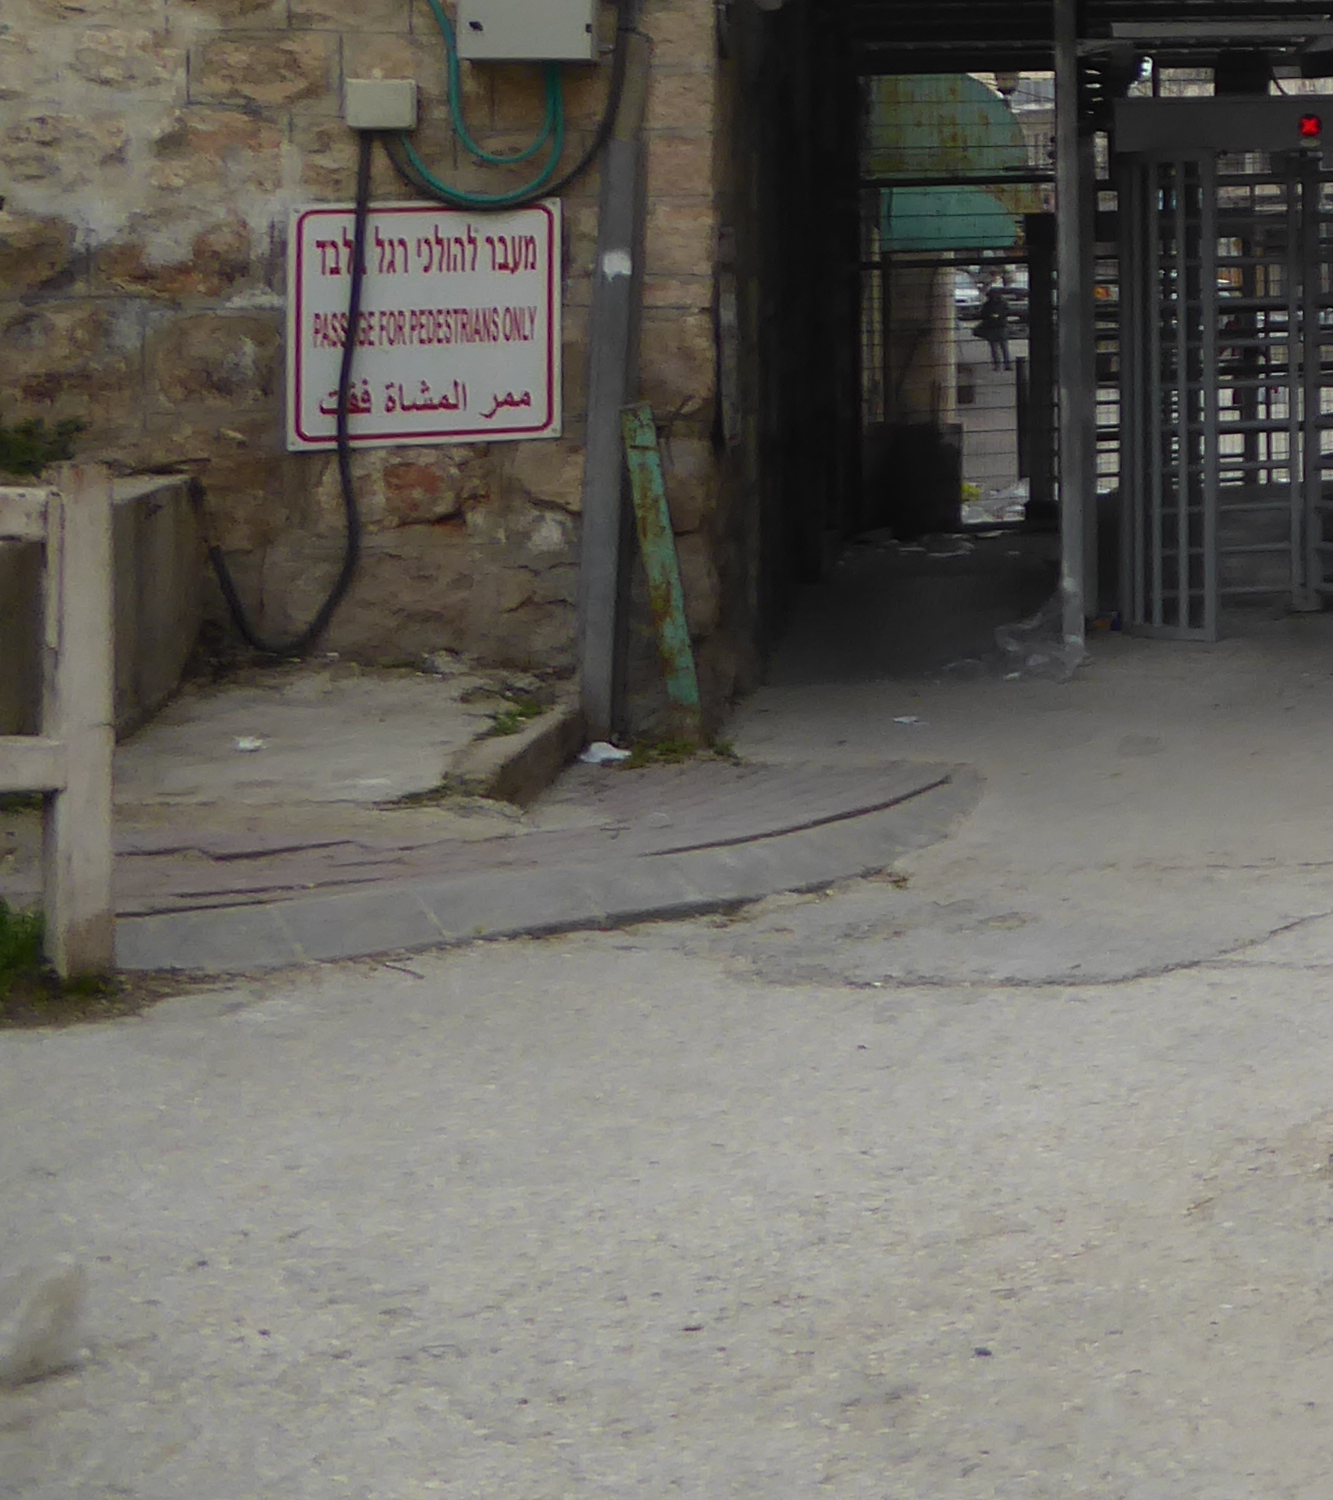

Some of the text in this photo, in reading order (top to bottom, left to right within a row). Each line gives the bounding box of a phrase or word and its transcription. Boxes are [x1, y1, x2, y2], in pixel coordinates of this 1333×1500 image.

[374, 225, 409, 274] רגל
[416, 223, 478, 274] להולכי
[485, 234, 537, 274] מעבר
[313, 304, 538, 349] PASSGE FOR PEDESTRIANS ONLY
[384, 378, 468, 413] المشاة
[479, 390, 532, 419] ممر
